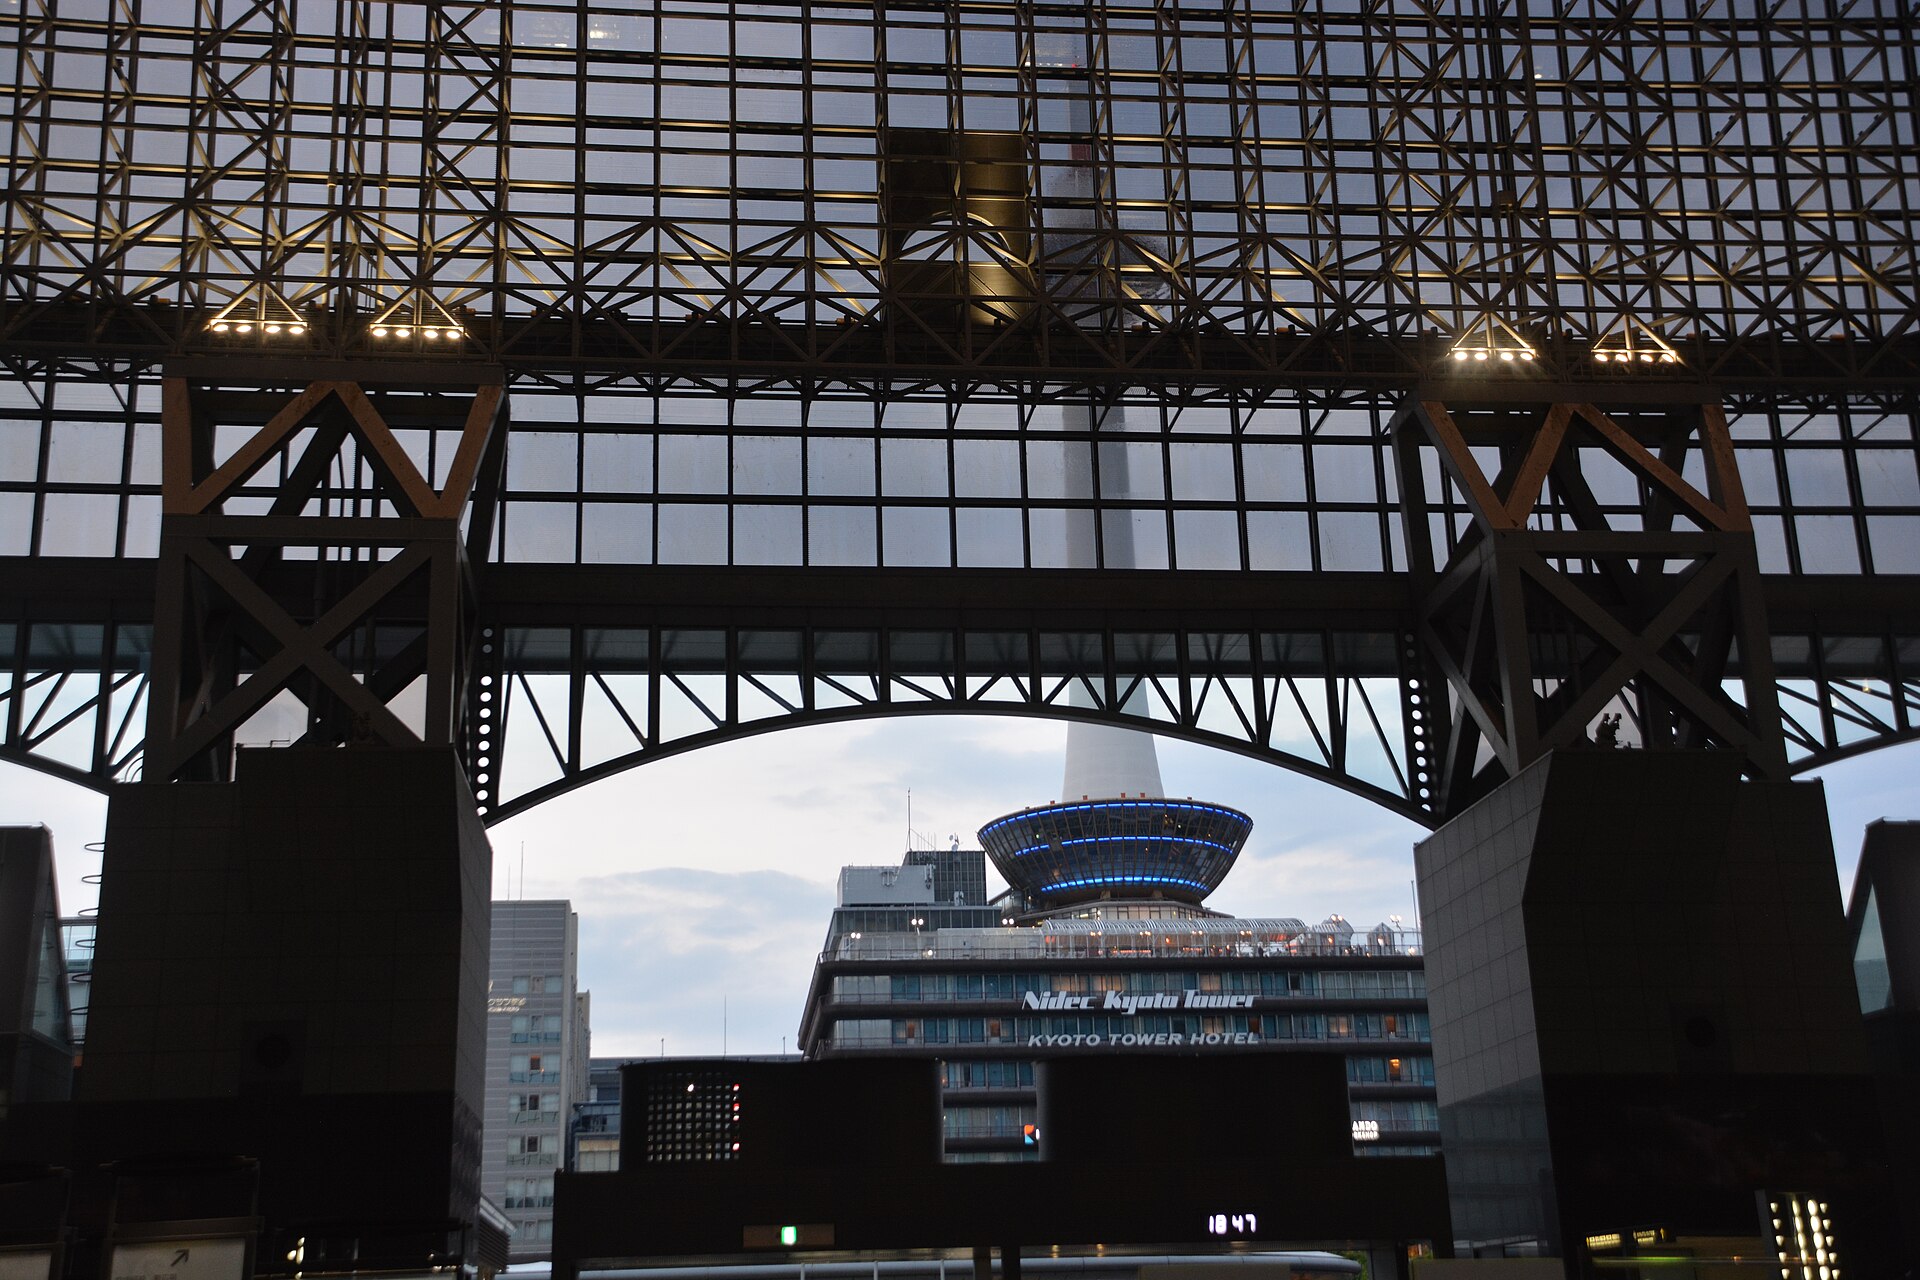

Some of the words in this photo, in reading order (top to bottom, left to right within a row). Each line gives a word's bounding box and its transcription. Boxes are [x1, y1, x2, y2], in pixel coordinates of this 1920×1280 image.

[1022, 990, 1097, 1010] Nidec
[1103, 990, 1179, 1014] Kyoto
[1183, 989, 1260, 1008] Tower
[1028, 1033, 1101, 1047] KYOTO
[1109, 1033, 1182, 1046] TOWER
[1190, 1032, 1259, 1045] HOTEL
